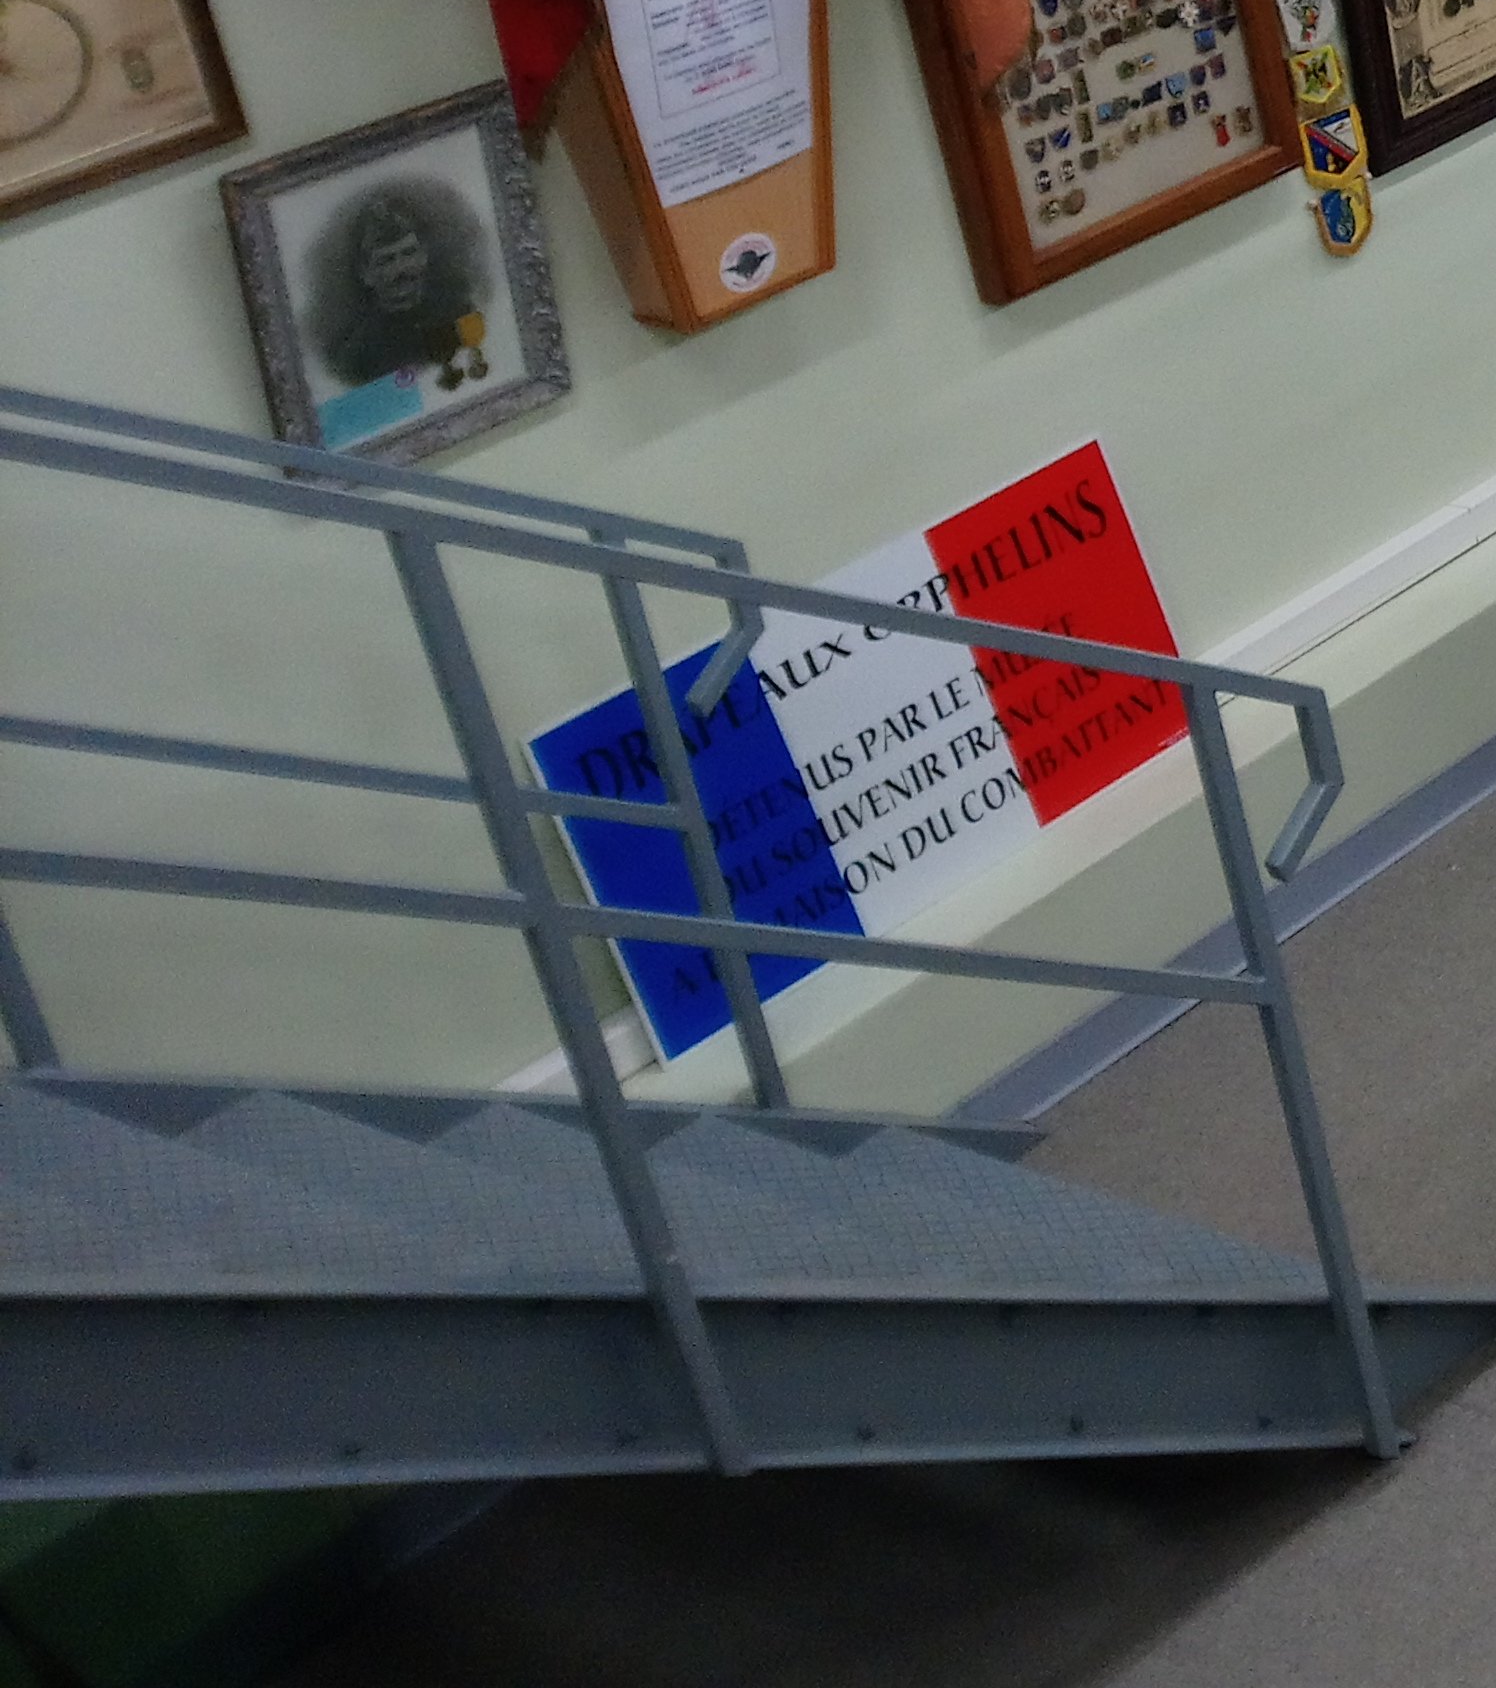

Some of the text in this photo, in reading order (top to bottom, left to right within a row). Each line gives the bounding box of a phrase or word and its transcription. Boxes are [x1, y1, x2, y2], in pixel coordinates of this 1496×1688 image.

[855, 702, 928, 763] PAR
[927, 674, 973, 731] LE
[899, 806, 957, 862] DU
[959, 676, 1170, 825] COMBATTANT
[770, 750, 948, 875] SOUVENIR
